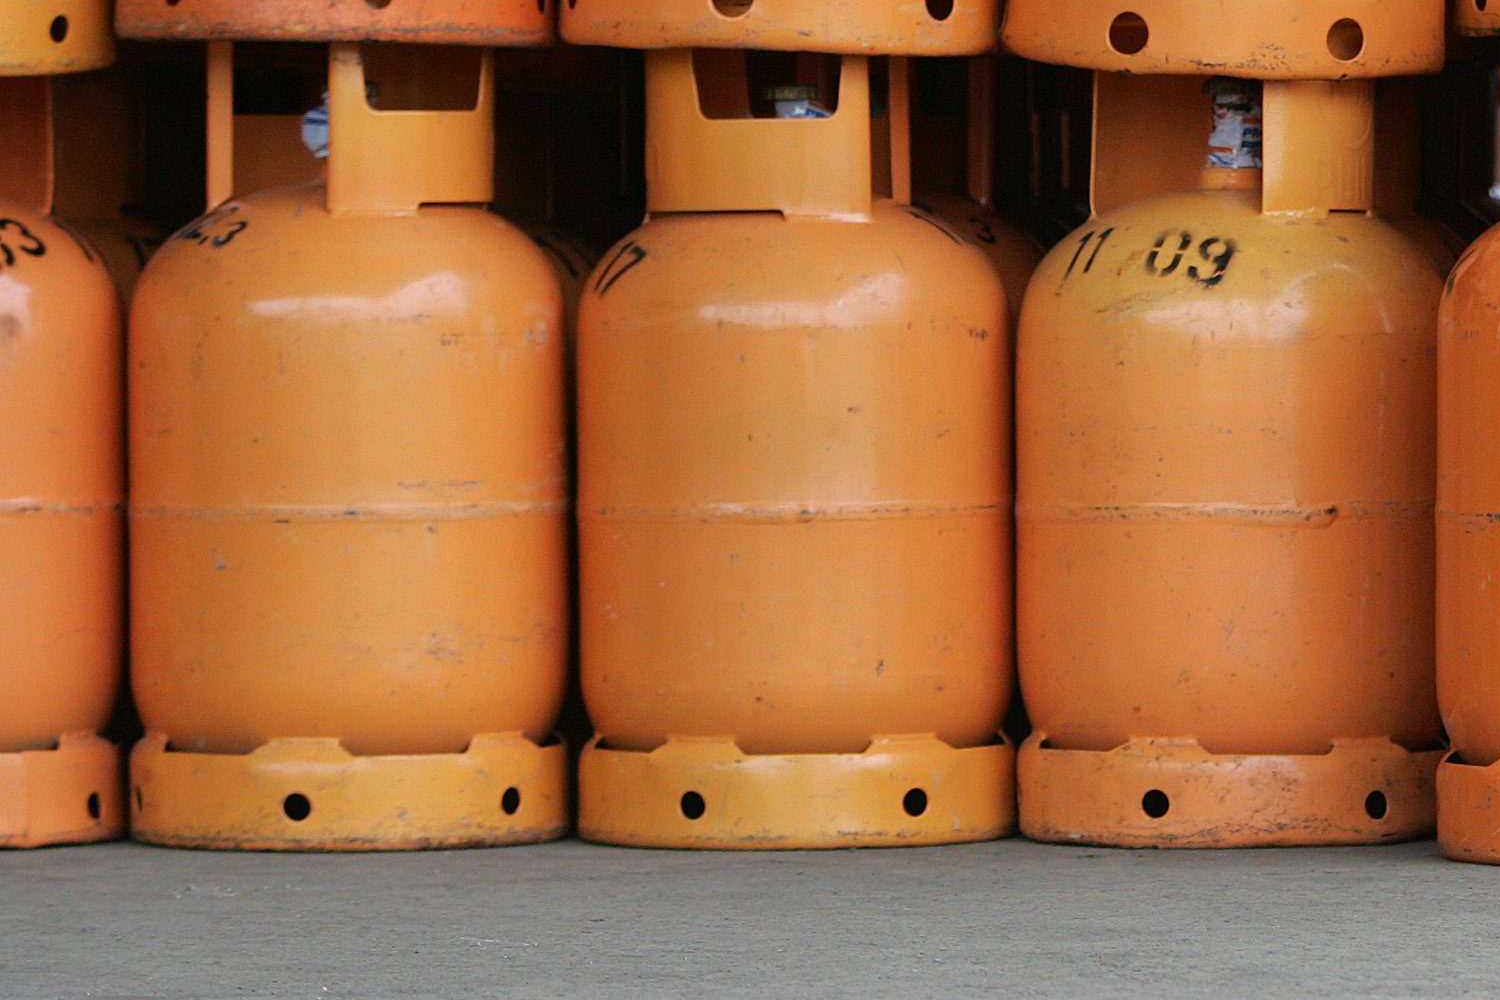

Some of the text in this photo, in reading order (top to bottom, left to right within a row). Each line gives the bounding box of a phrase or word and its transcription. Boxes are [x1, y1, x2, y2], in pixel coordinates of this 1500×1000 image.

[594, 240, 647, 296] 17
[1059, 227, 1238, 290] 11 09
